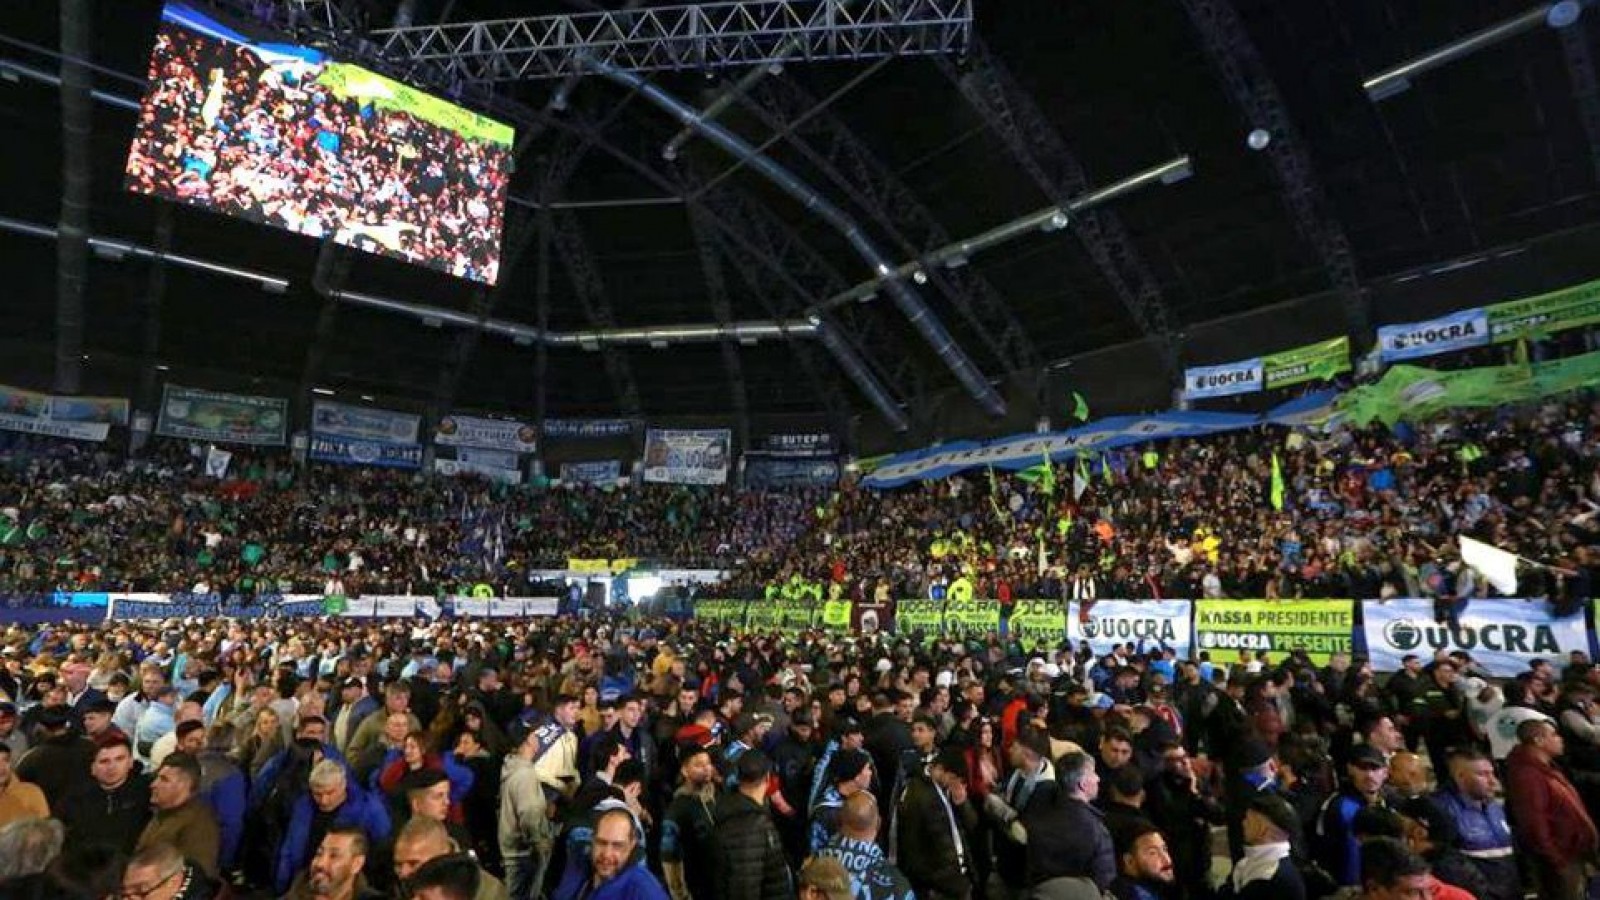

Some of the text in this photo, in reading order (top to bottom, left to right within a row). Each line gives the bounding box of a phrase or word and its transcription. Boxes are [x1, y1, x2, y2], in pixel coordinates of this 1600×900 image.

[1412, 321, 1475, 345] UOCRA
[1208, 370, 1254, 387] UOCRA
[1102, 618, 1175, 640] UOCRA
[1257, 611, 1349, 627] PRESIDENTE
[1217, 633, 1352, 652] UOCRA PRESENTE
[1425, 623, 1561, 653] UOCRA
